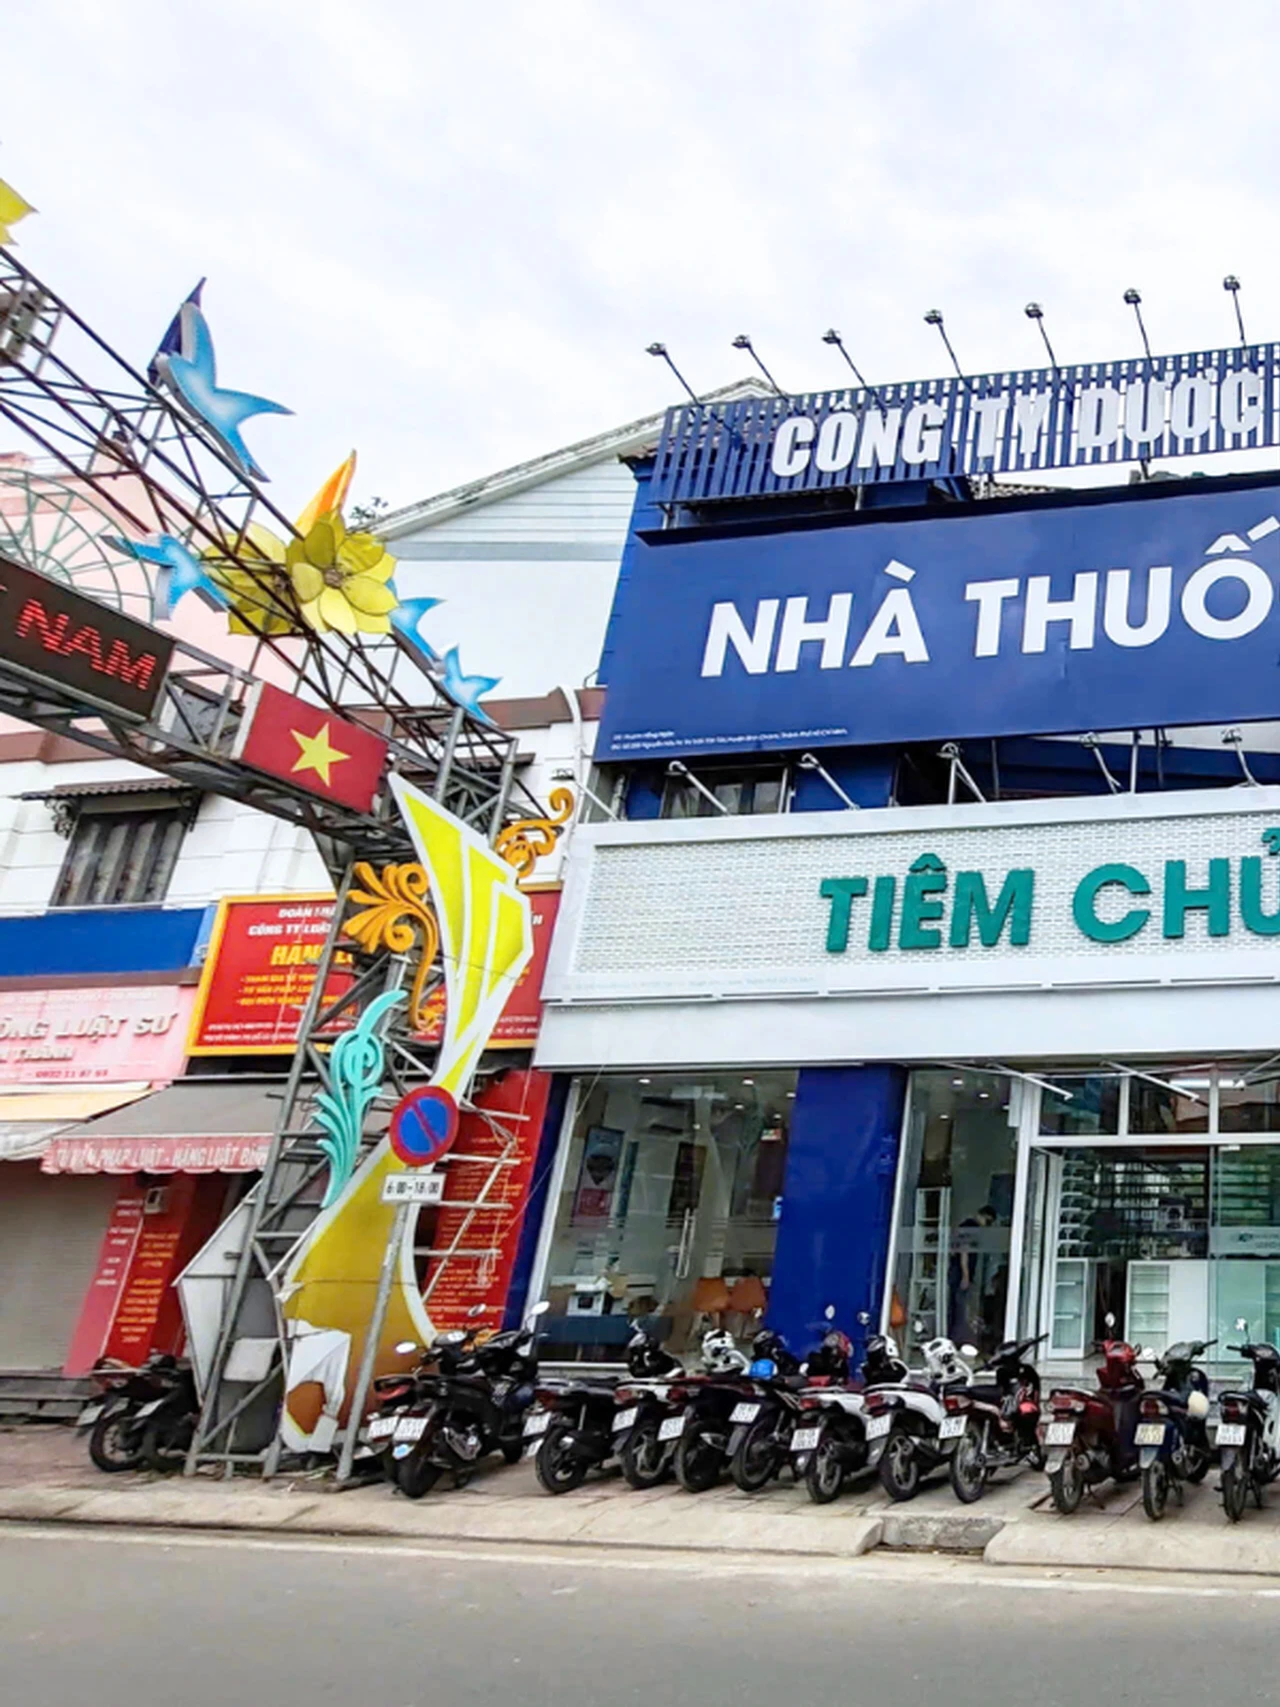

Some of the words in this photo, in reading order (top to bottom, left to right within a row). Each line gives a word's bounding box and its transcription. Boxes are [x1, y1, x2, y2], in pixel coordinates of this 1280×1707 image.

[771, 401, 946, 477] CÔNG
[970, 391, 1052, 457] TY
[15, 598, 157, 691] NAM
[701, 559, 931, 678] NHÀ
[820, 852, 1034, 953] TIÊM
